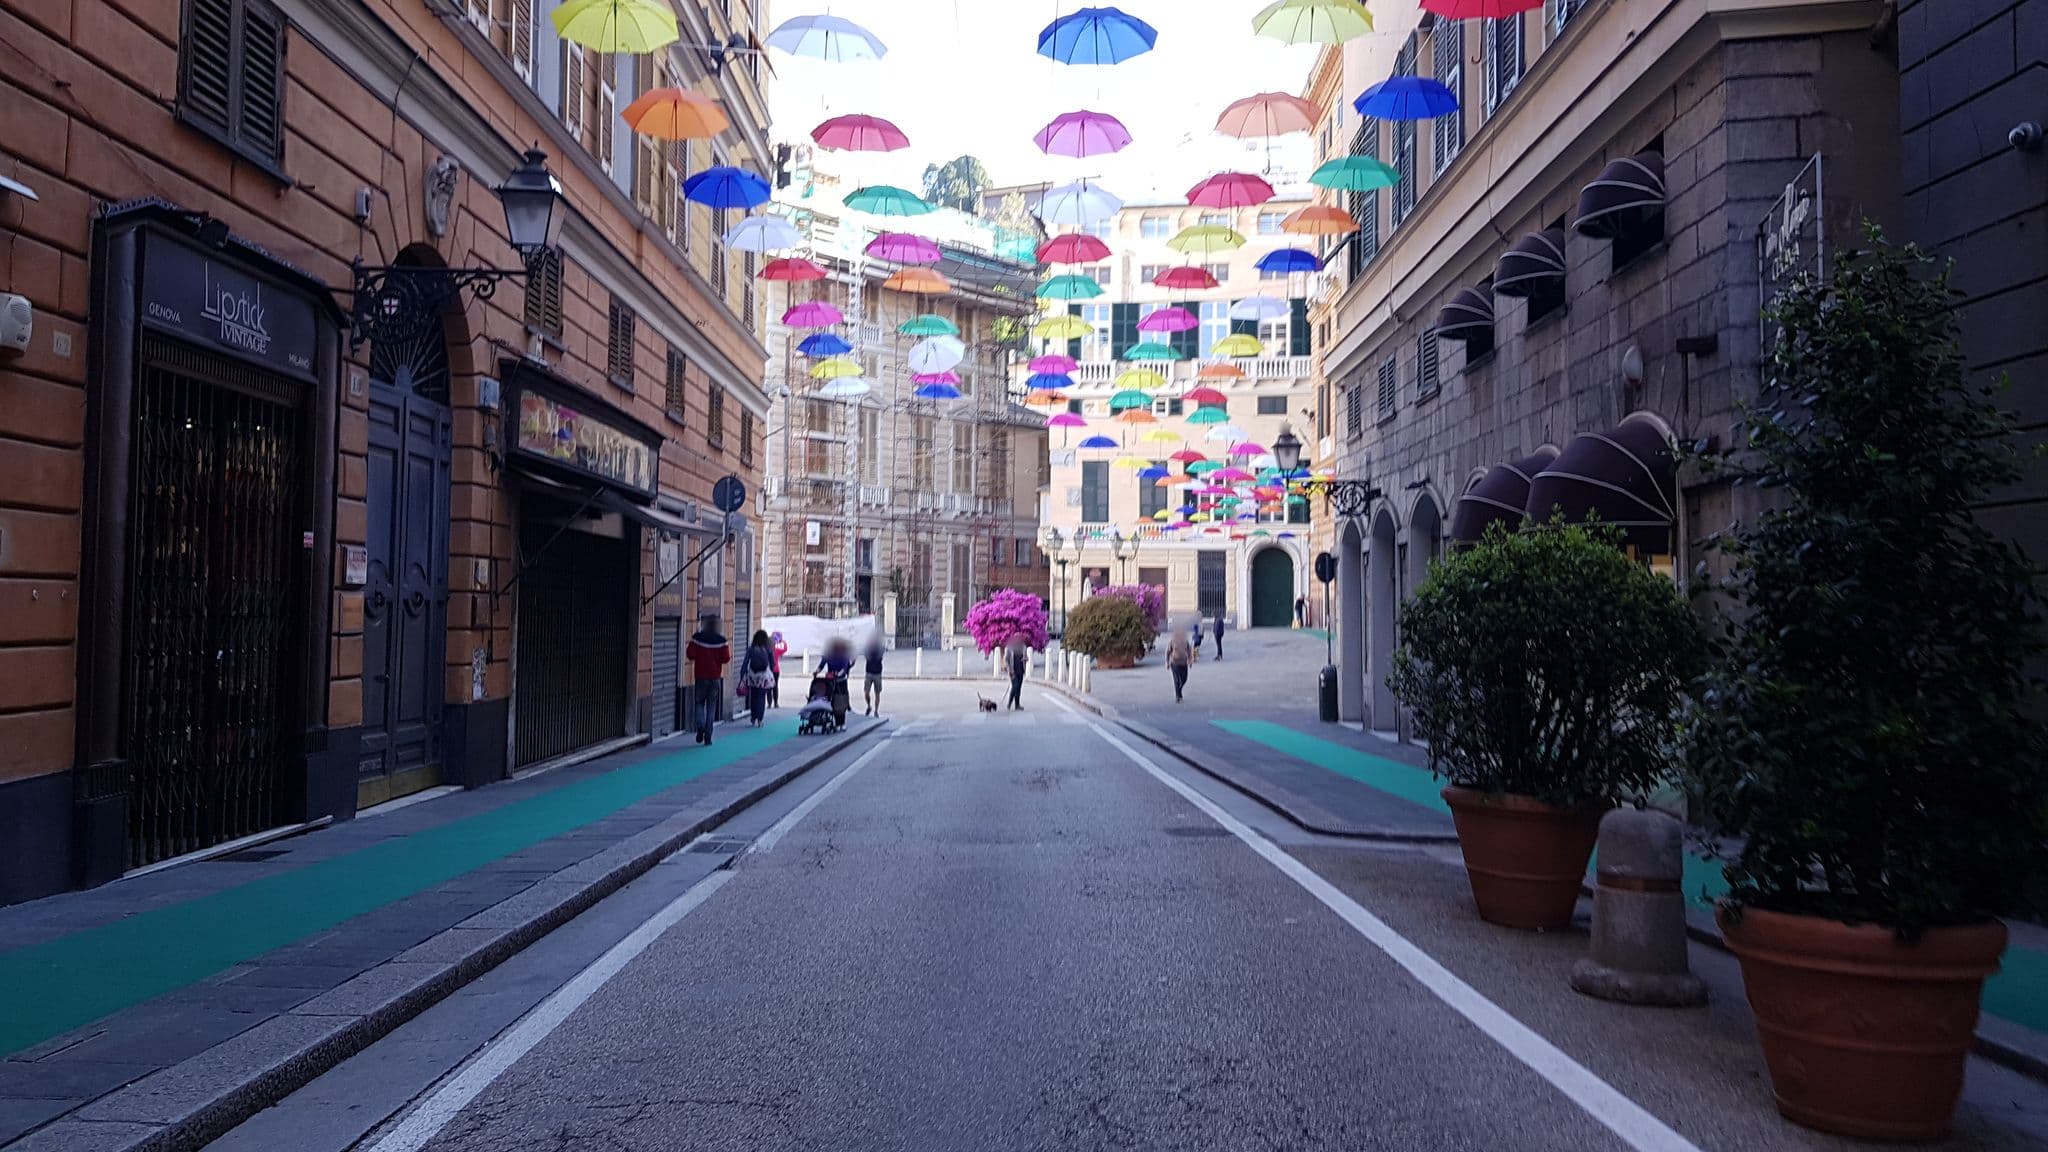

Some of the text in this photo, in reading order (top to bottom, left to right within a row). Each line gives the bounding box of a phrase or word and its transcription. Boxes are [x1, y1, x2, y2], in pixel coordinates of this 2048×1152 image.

[149, 302, 181, 323] GENOVA
[204, 261, 267, 339] Lipstick
[224, 325, 267, 354] VINTAGE
[288, 352, 311, 369] MILANO
